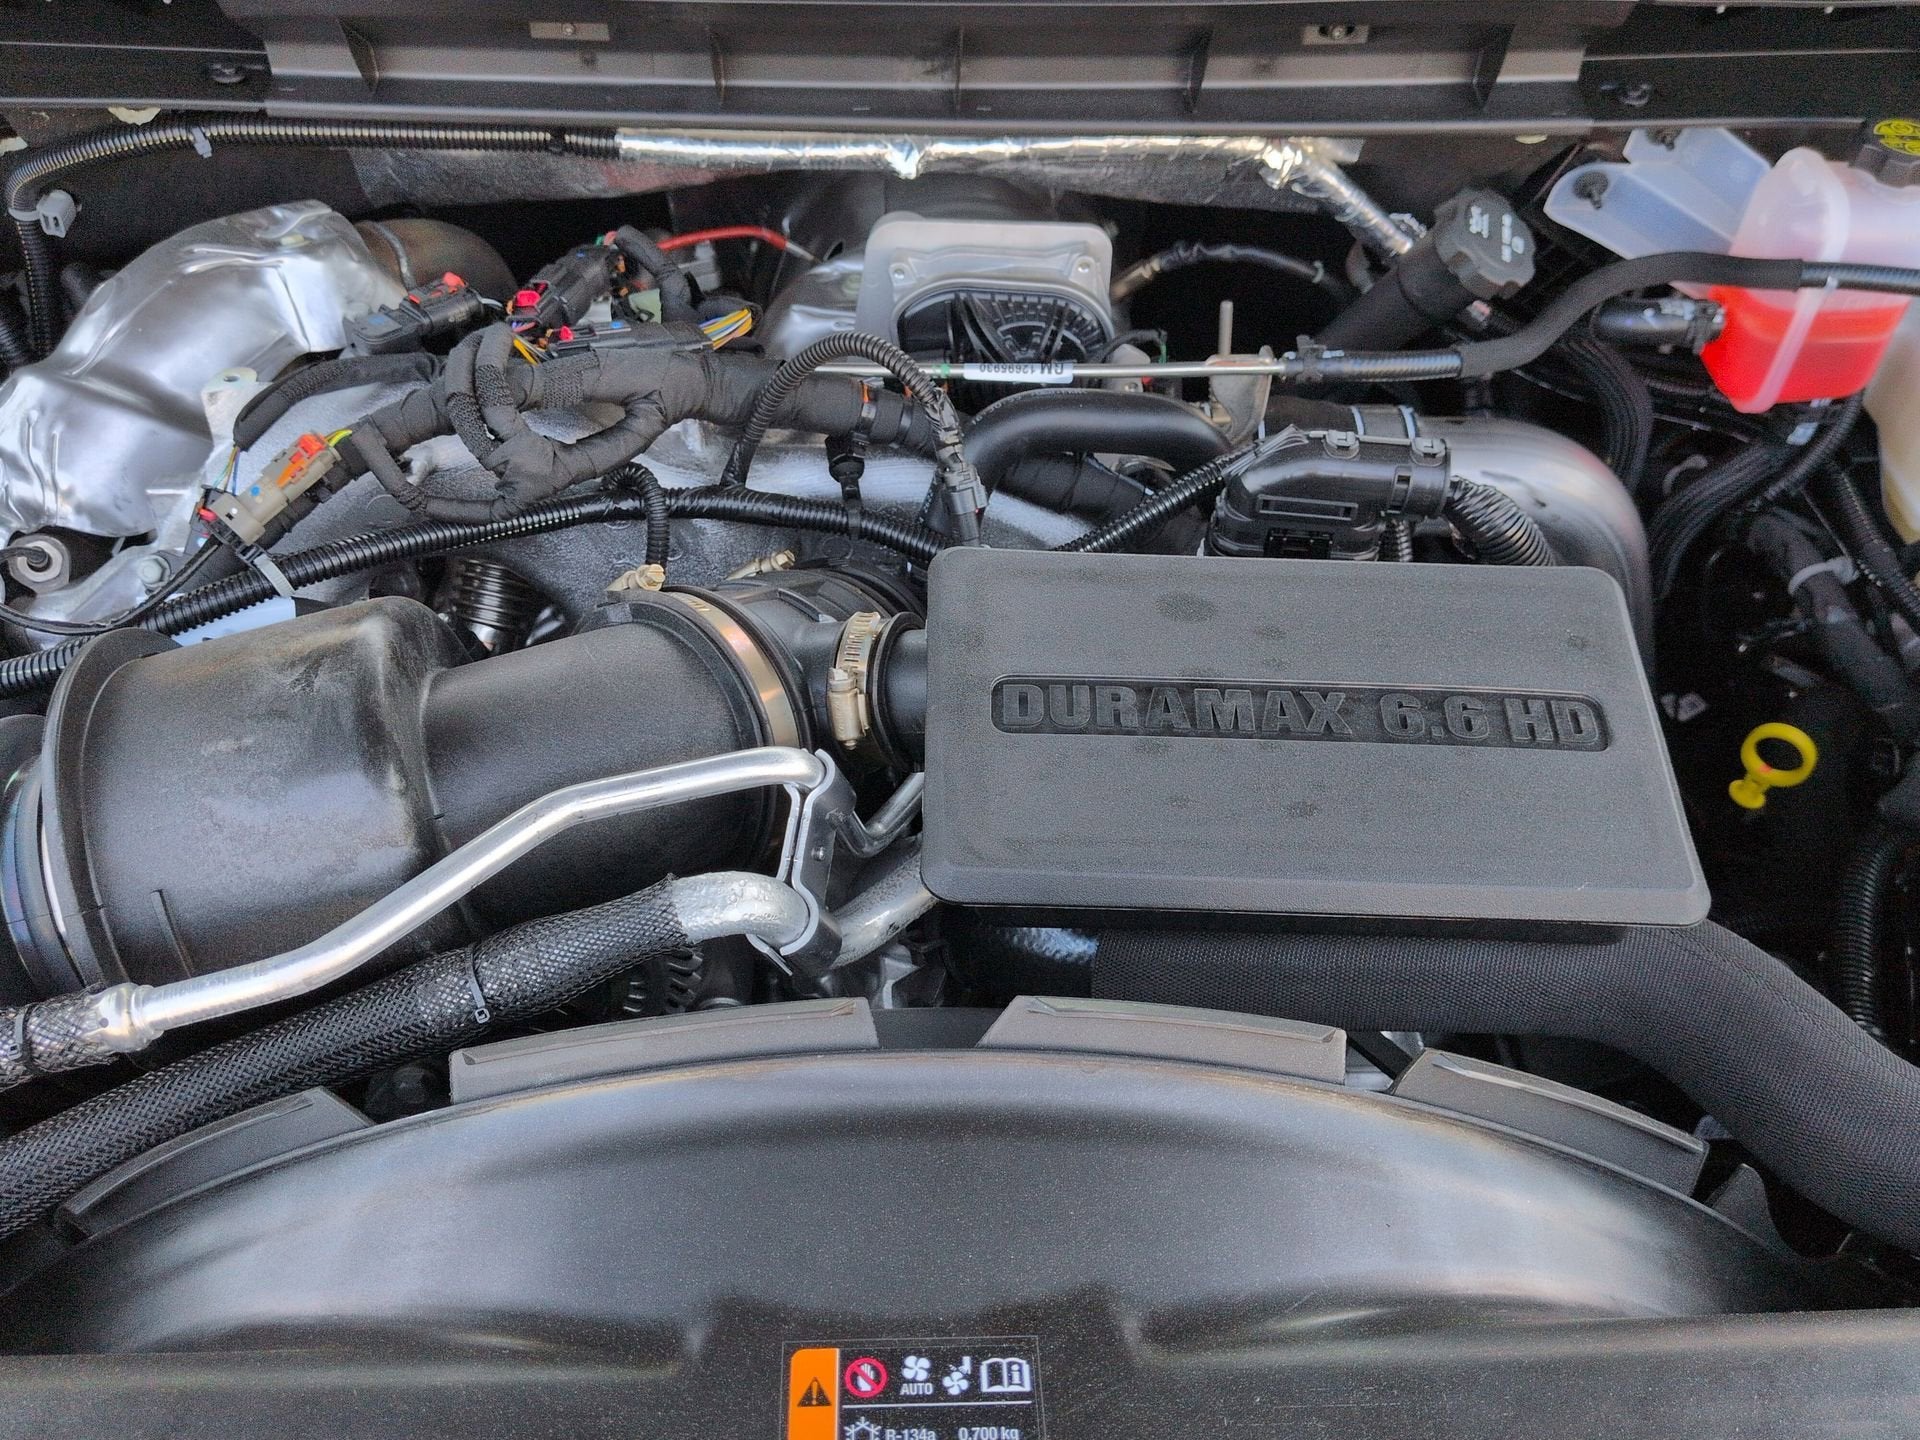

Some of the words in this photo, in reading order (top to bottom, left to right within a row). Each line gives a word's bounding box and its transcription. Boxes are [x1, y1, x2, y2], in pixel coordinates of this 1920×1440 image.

[1039, 363, 1065, 375] GM
[1002, 684, 1352, 736] DURAMAX
[1379, 693, 1491, 740] 6.6
[1503, 698, 1600, 746] HD
[900, 1382, 933, 1395] AUTO
[885, 1428, 936, 1440] R-134a
[958, 1427, 997, 1440] 0.700
[1000, 1426, 1019, 1440] kg
